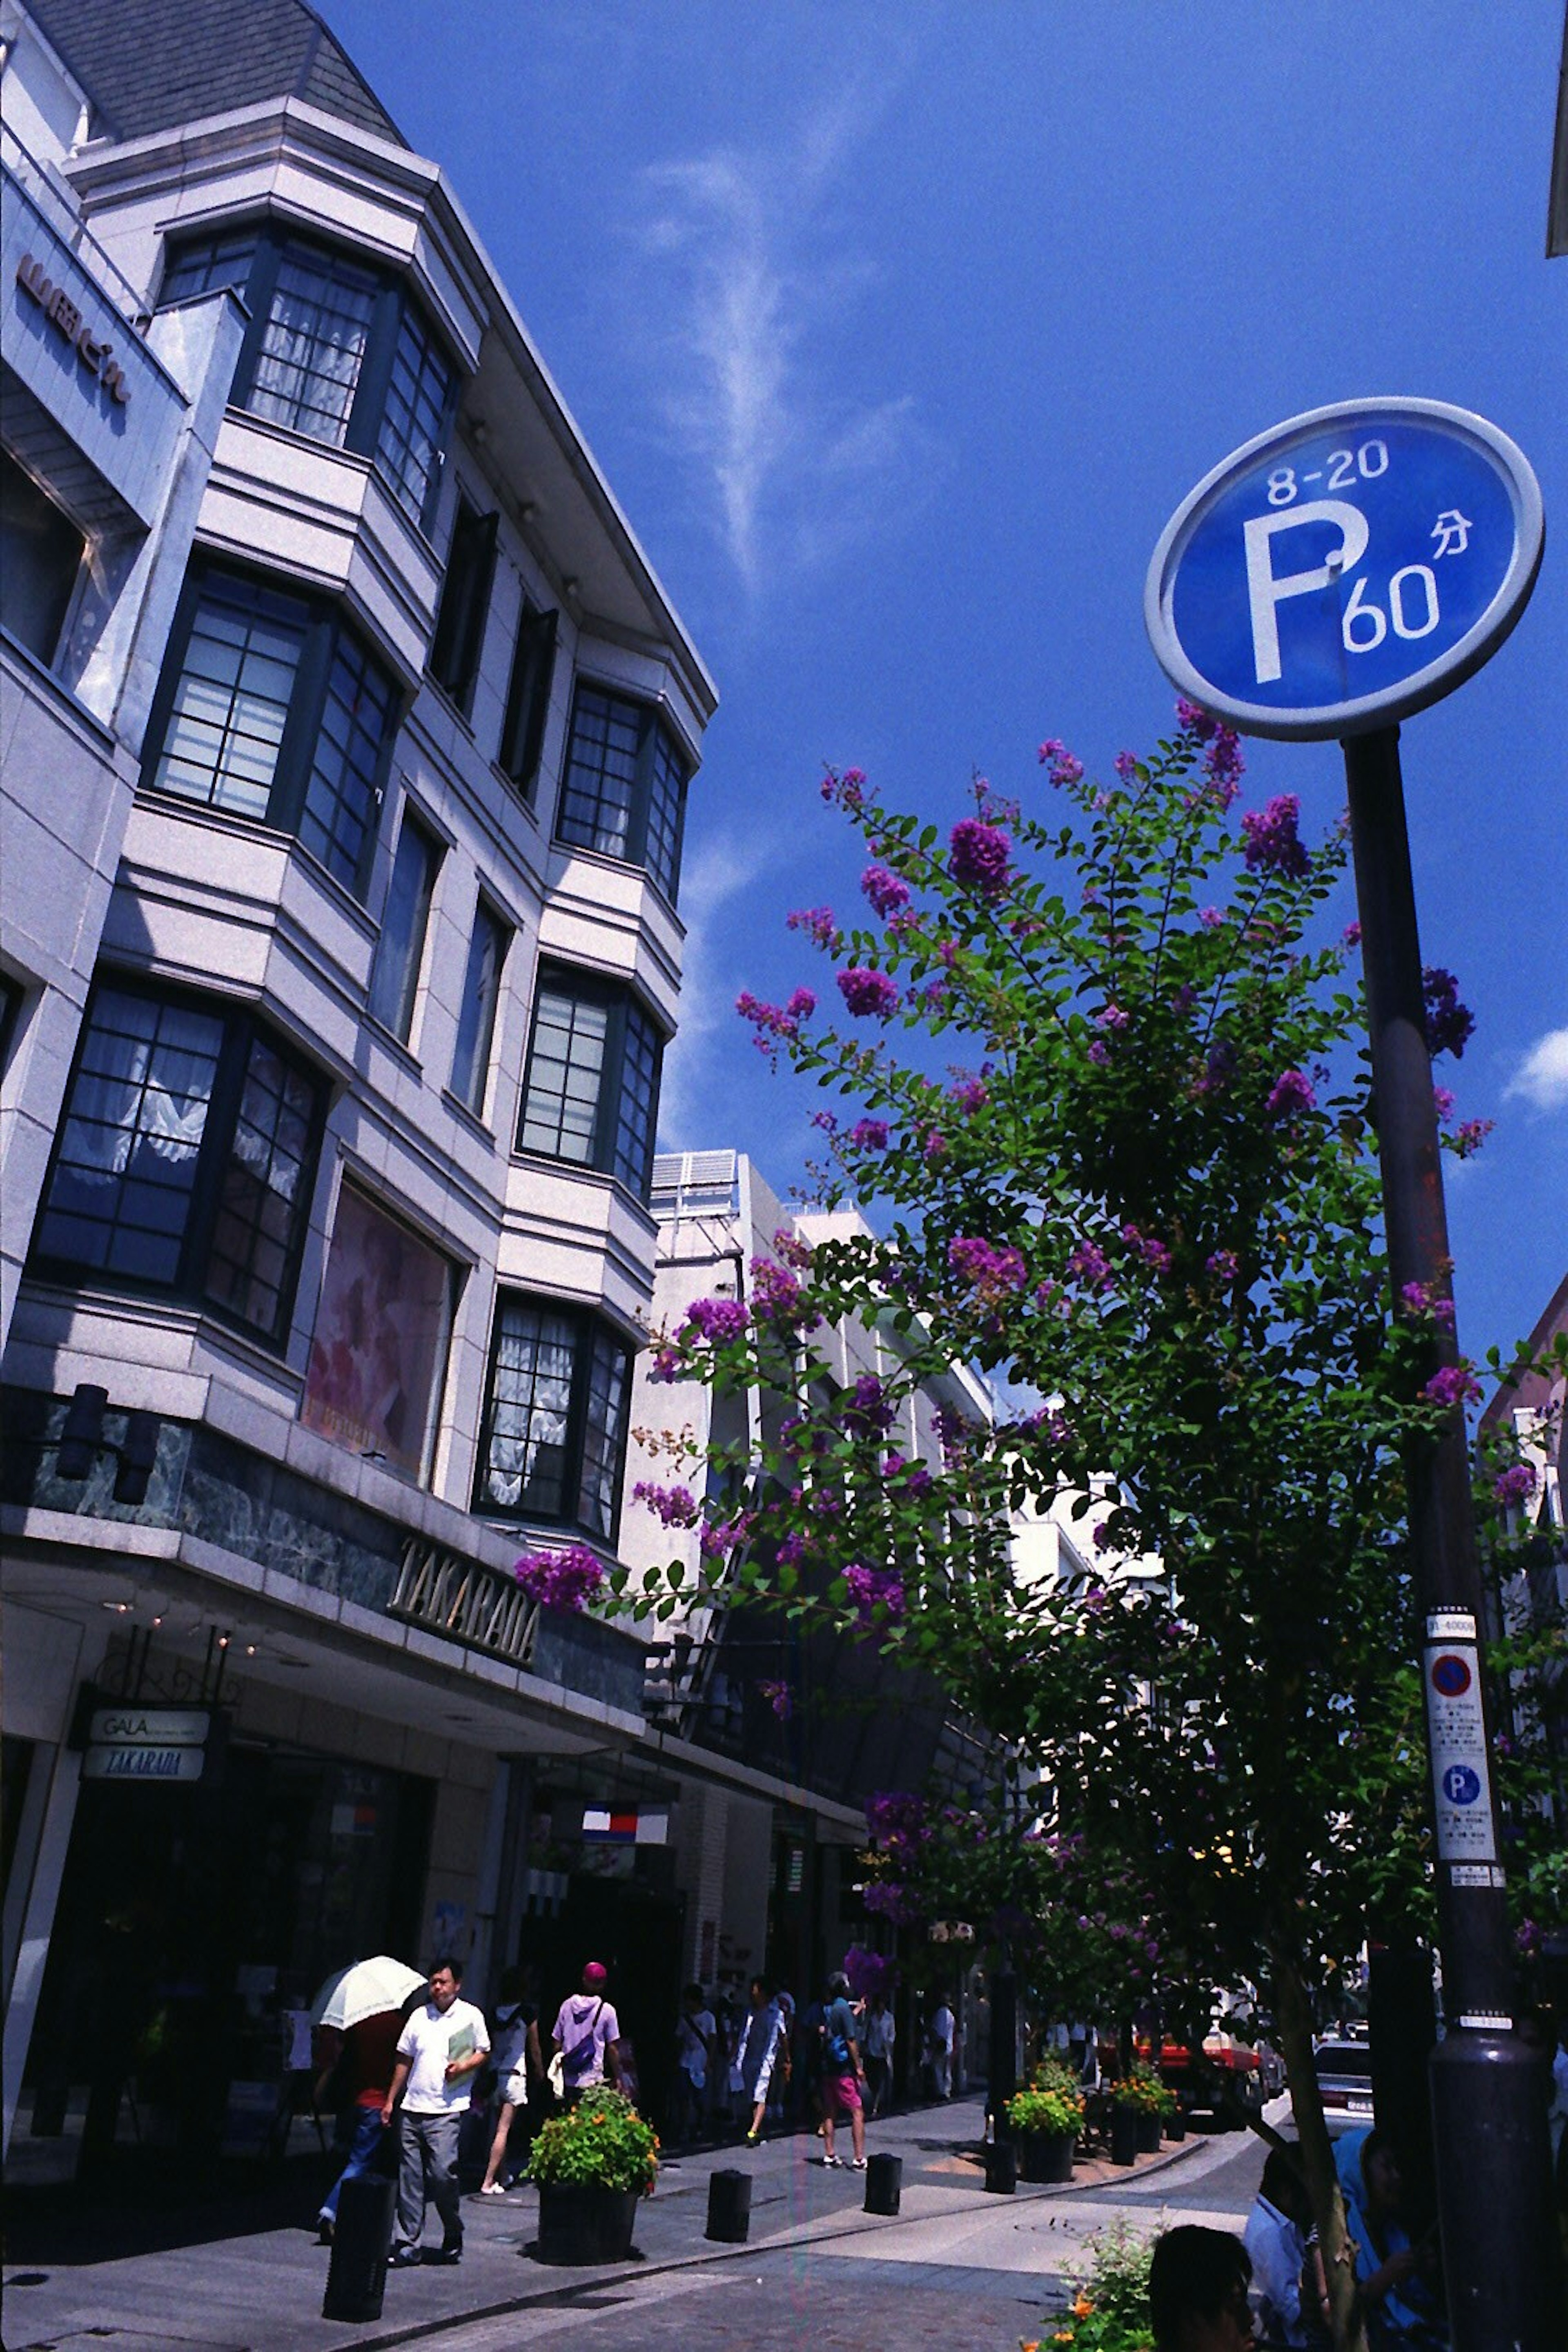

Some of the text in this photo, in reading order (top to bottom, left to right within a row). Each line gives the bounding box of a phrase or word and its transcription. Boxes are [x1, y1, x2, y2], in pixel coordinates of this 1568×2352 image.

[16, 253, 131, 403] 山岡ビル
[1267, 439, 1389, 505] 8-20
[1430, 509, 1473, 560] 分
[1243, 499, 1370, 684] P
[1342, 564, 1440, 653] 60
[387, 1537, 541, 1663] TAKARADA
[104, 1717, 147, 1735] GALA
[106, 1750, 181, 1775] TAKARADA
[1450, 1773, 1466, 1798] P
